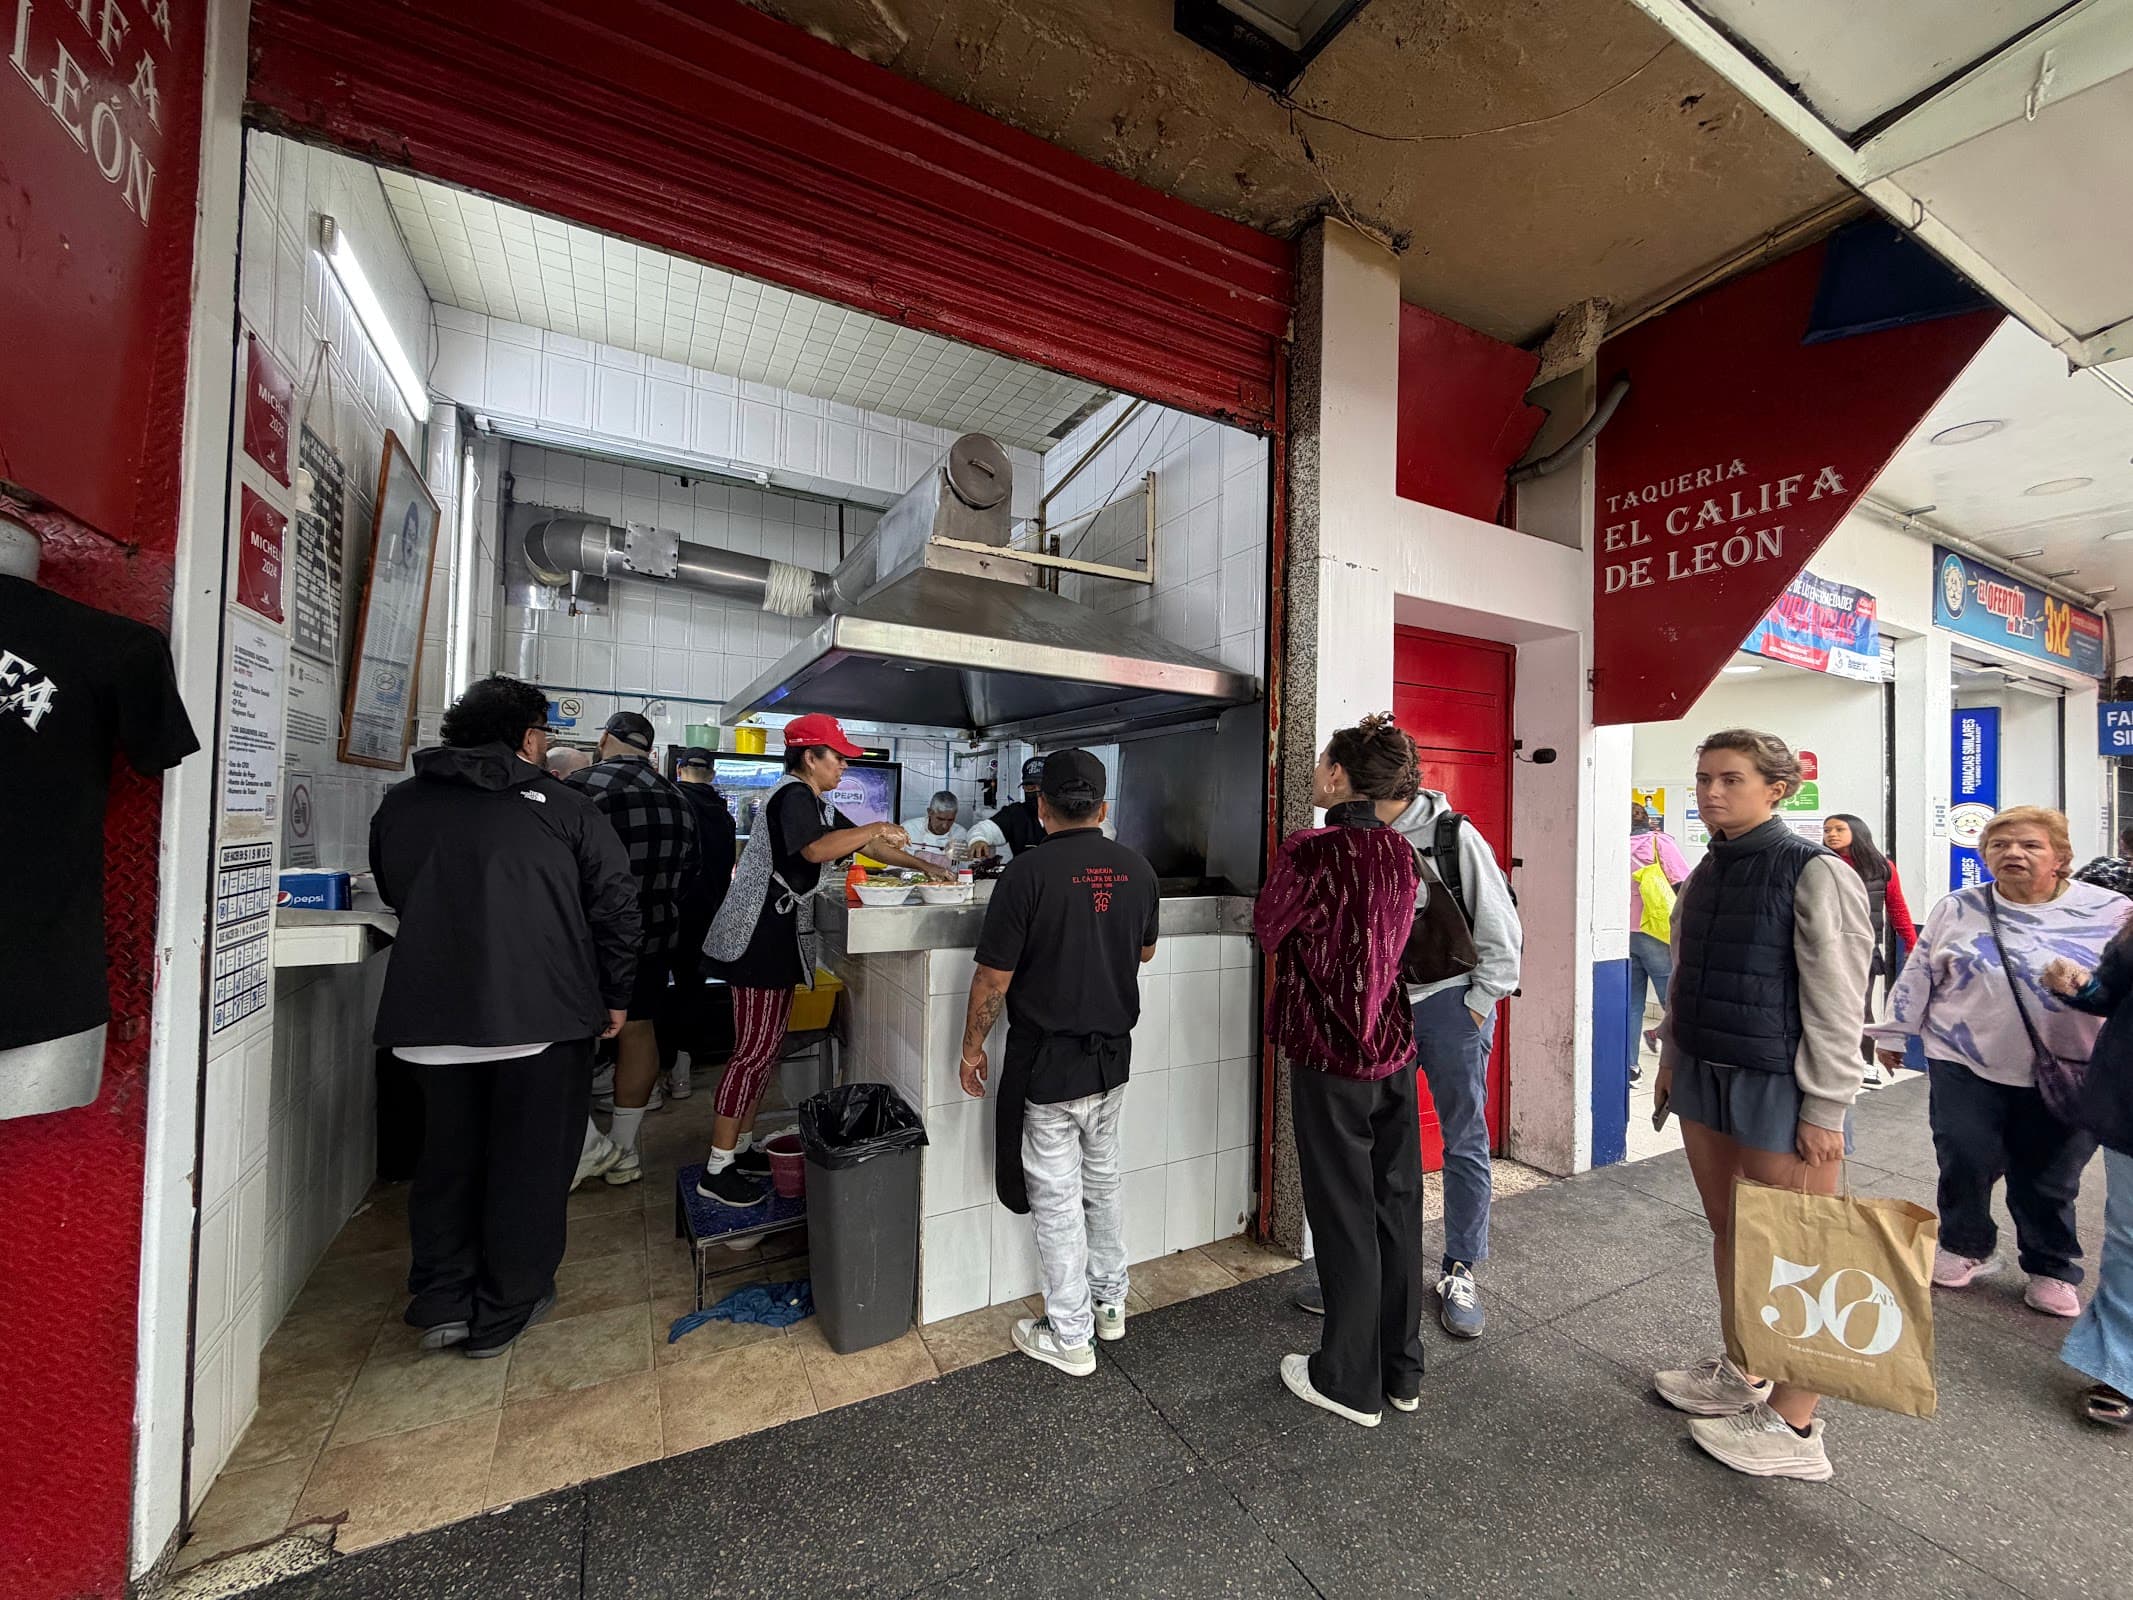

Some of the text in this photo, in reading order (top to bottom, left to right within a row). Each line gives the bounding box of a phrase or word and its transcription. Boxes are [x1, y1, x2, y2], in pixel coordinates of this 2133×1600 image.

[1606, 458, 1748, 514] TAQUERIA
[1604, 465, 1848, 553] EL CALIFA
[1604, 526, 1785, 594] DE LEÓN
[1978, 580, 2025, 619] EL OFERTÓN
[2107, 711, 2133, 727] FA
[2113, 730, 2133, 746] SI
[1962, 718, 1976, 794] FARMACIAS SIMILARES
[833, 791, 863, 801] PEPSI
[1072, 876, 1081, 884] EL
[293, 893, 325, 905] pepsi
